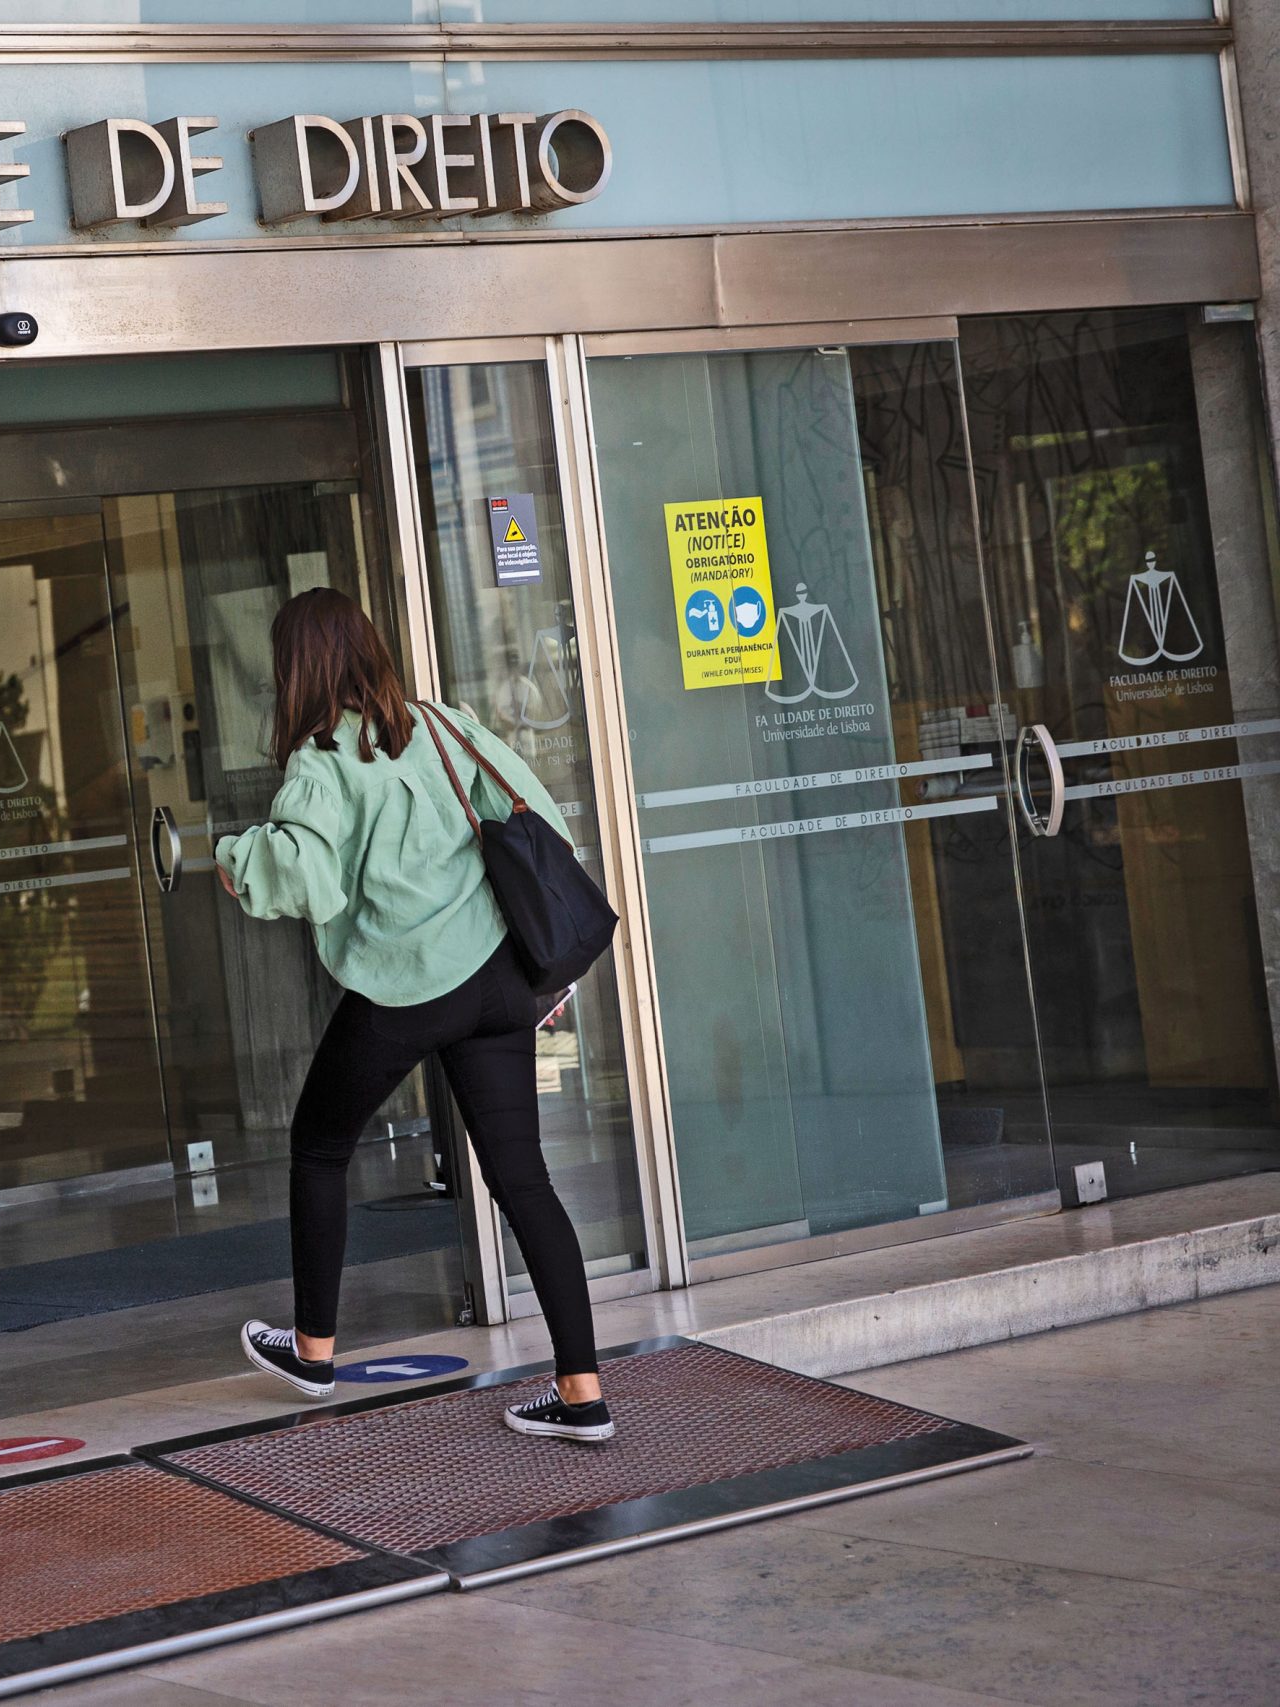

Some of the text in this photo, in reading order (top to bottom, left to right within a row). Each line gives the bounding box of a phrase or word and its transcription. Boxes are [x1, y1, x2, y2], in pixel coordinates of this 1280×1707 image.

[106, 116, 228, 219] DE
[293, 109, 613, 211] DIREITO
[675, 505, 756, 533] ATENÇÃO
[687, 532, 746, 553] (NOTICE)
[686, 552, 755, 569] OBRIGATÓRIO
[690, 567, 754, 584] (MANDATORY)
[686, 647, 719, 658] DURANTE
[726, 643, 774, 654] PERMANÊNCIA
[701, 670, 724, 679] (WHILE
[724, 668, 733, 676] ON
[1108, 665, 1218, 688] FACULDADE DE DIREITO
[1174, 684, 1185, 696] de
[1186, 681, 1214, 695] Lisboa
[755, 703, 875, 728] FAULDADE DE DIREITO
[763, 719, 871, 743] Universidade de Lisboa
[1093, 733, 1168, 752] FACULDADE
[1178, 731, 1190, 742] DE
[735, 764, 909, 796] FACULDADE DE DIREITO
[1098, 766, 1254, 794] FACULDADE DE DIREIO
[7, 796, 42, 808] DIREITO
[0, 811, 11, 822] de
[741, 807, 913, 840] FACULDADE DE DIREITO
[0, 845, 49, 858] DIREITO
[4, 878, 52, 891] DIREITO
